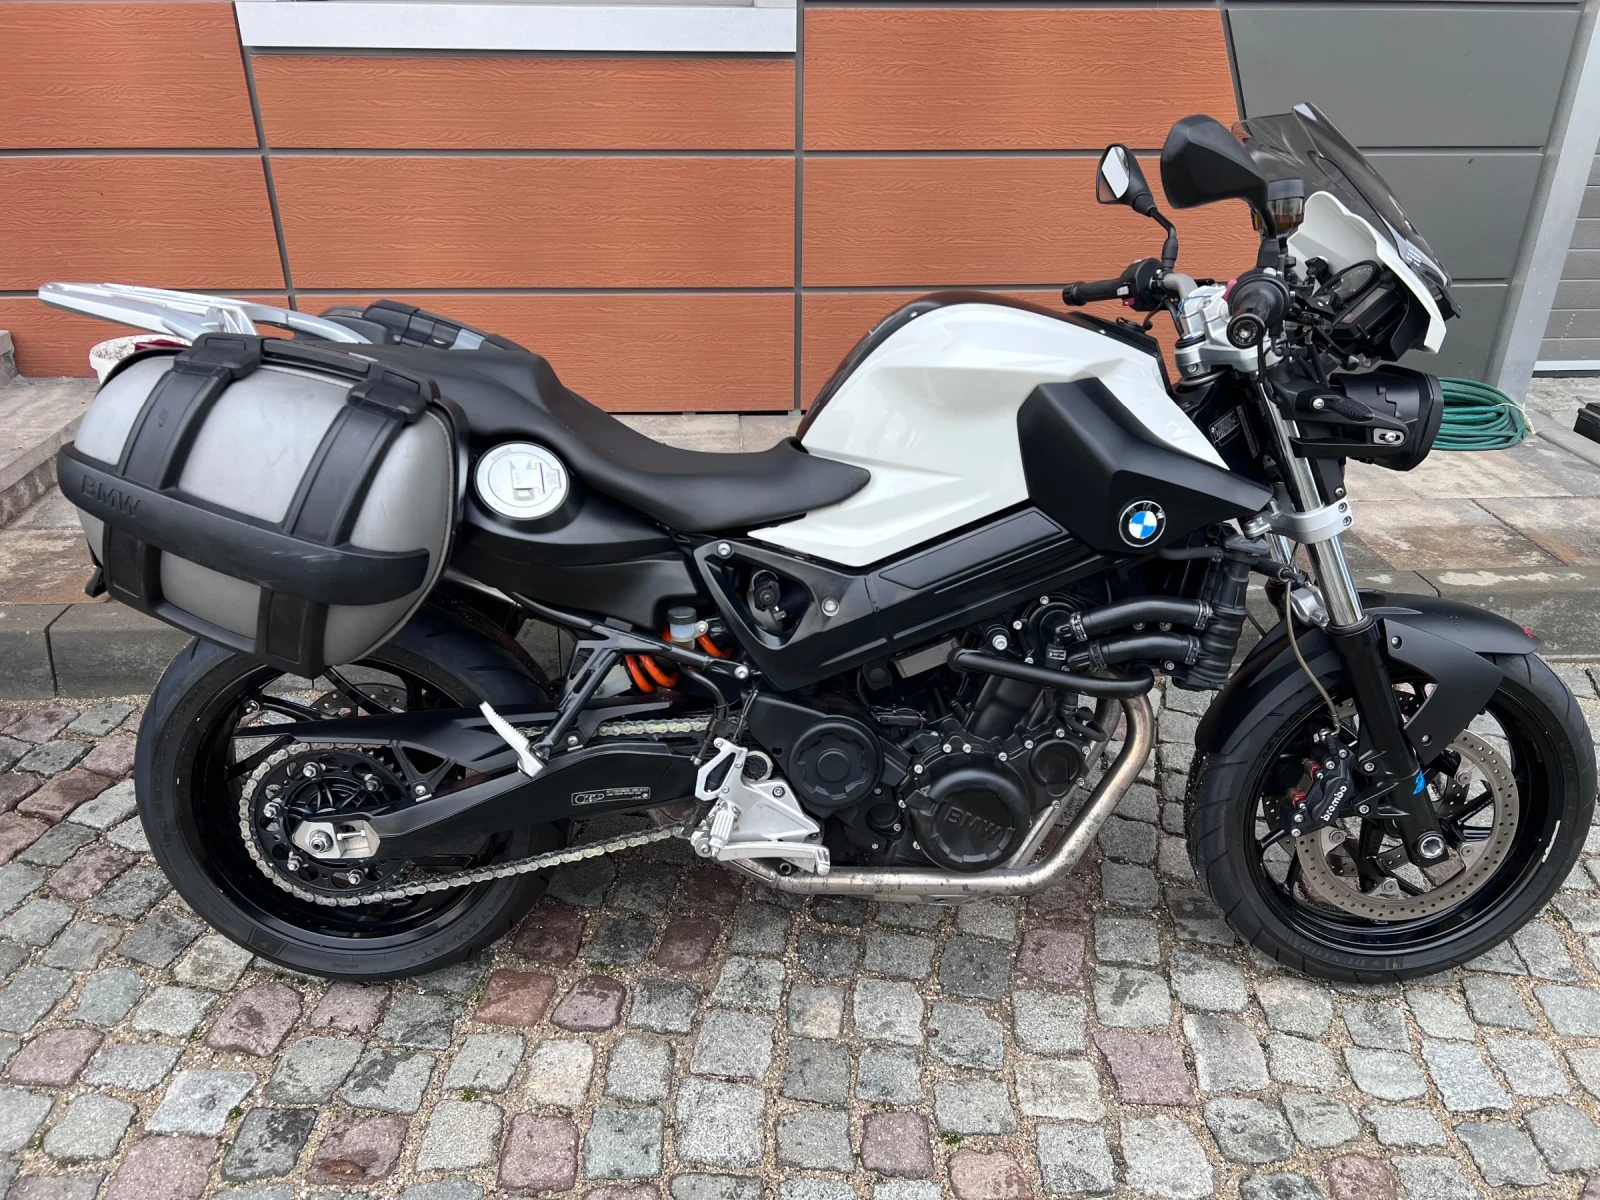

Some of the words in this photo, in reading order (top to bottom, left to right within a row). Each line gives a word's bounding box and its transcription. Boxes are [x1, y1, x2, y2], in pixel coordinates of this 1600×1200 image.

[81, 474, 141, 518] BMW
[1320, 785, 1348, 822] brembo
[944, 804, 1001, 841] BMW
